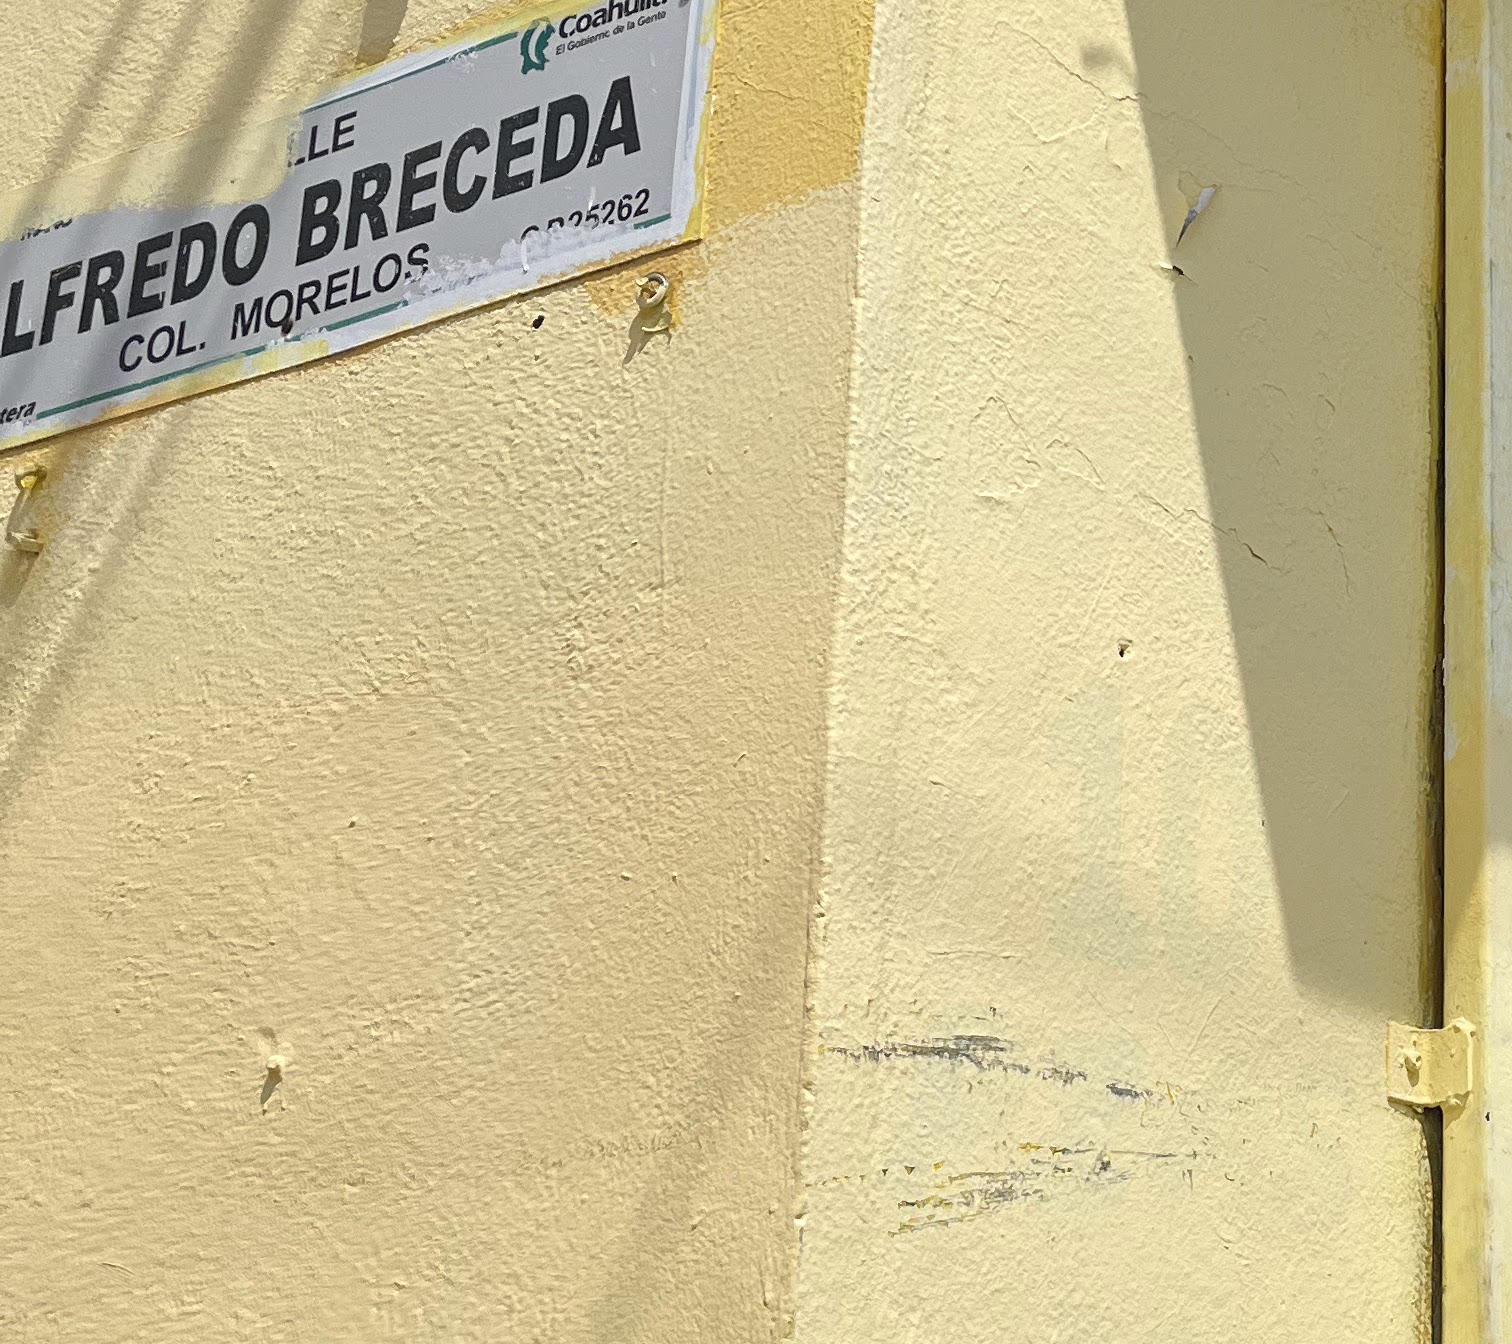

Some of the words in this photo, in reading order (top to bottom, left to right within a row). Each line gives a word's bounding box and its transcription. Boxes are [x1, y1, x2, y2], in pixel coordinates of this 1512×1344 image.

[555, 44, 566, 56] El
[612, 25, 625, 36] de
[626, 20, 636, 30] la
[637, 10, 667, 27] Gente
[295, 75, 642, 267] BRECEDA
[118, 320, 206, 373] COL.
[230, 242, 431, 341] MORELOS
